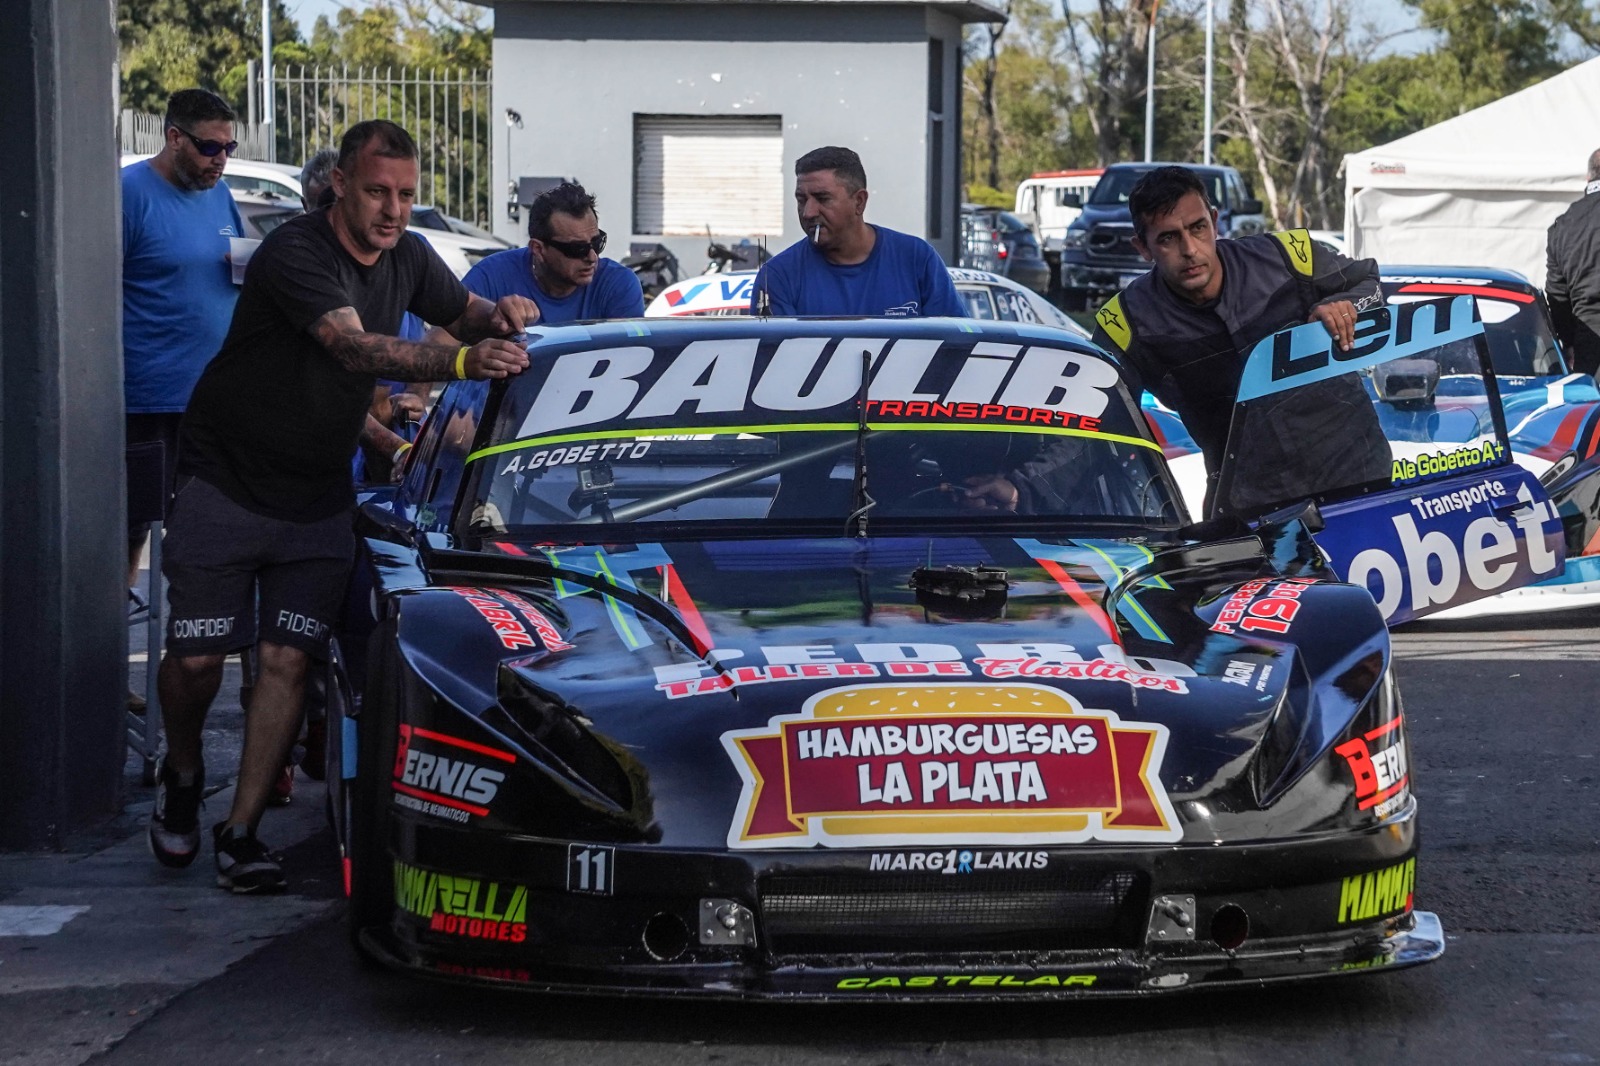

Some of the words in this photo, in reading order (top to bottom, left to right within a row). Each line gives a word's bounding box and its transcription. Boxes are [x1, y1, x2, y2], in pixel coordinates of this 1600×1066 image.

[858, 400, 1101, 432] TRANSPORTE
[1391, 457, 1416, 482] Ale
[1417, 447, 1481, 476] Gobetto
[1410, 480, 1506, 520] Transporte
[174, 617, 235, 638] CONFIDENT
[465, 597, 536, 650] ABRIL
[1239, 597, 1301, 633] 19
[656, 663, 879, 698] TALLER
[885, 662, 972, 677] DE
[797, 723, 1098, 759] HAMBURGUESAS
[857, 761, 912, 804] LA
[920, 760, 1048, 803] PLATA
[576, 849, 607, 891] 11
[430, 911, 528, 943] MOTORES
[837, 975, 1098, 988] CASTELAR
